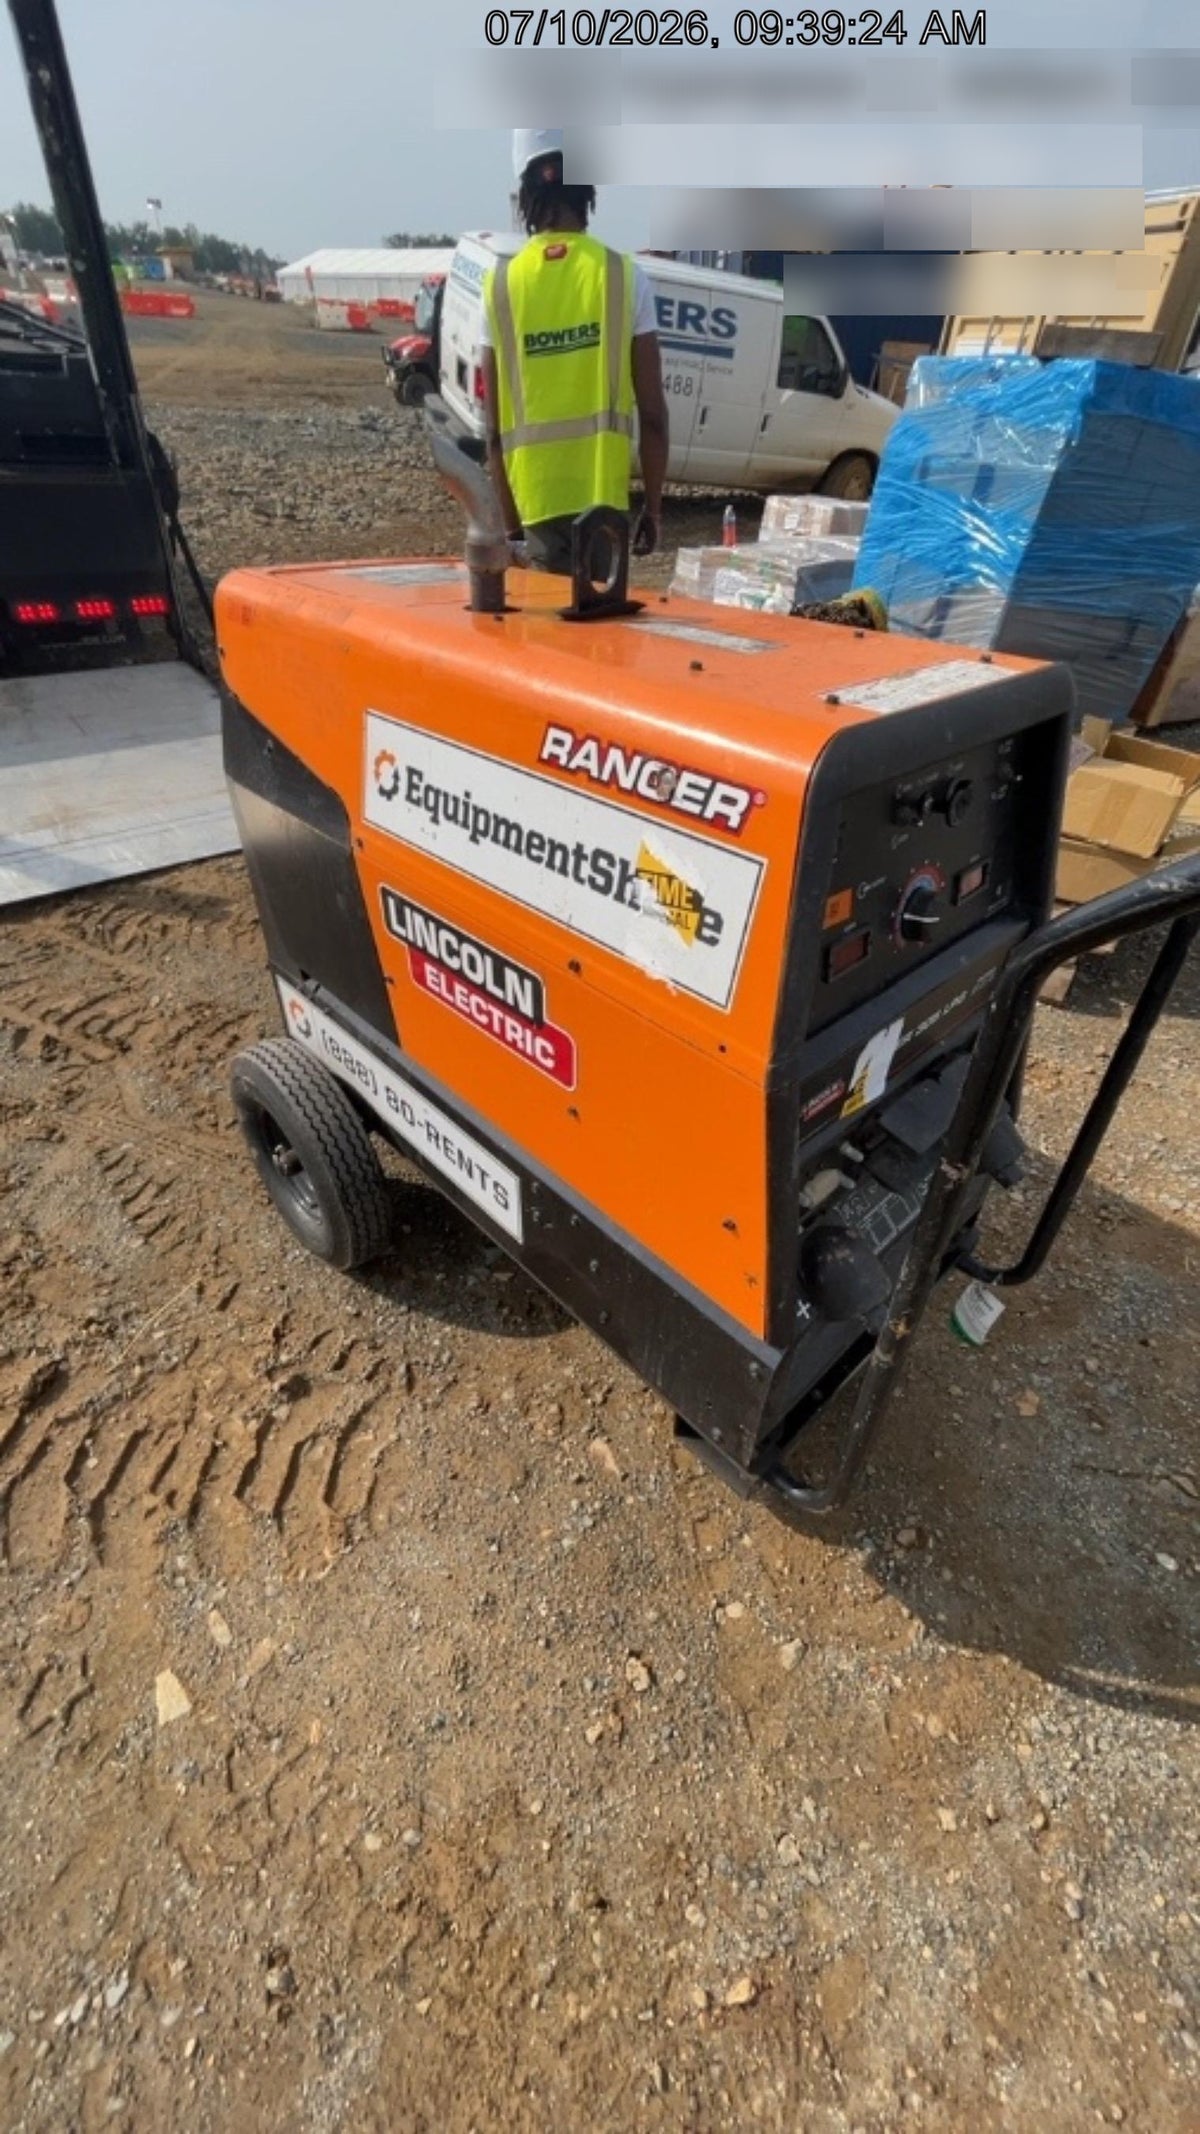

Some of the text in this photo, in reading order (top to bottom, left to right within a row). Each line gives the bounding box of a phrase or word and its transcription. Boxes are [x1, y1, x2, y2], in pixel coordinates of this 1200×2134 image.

[524, 321, 601, 348] BOWERS
[405, 765, 724, 947] EquipmentShe
[386, 894, 535, 1020] LINCOLN
[423, 961, 556, 1069] ELECTRIC
[320, 1028, 510, 1211] (888) 80-RENTS
